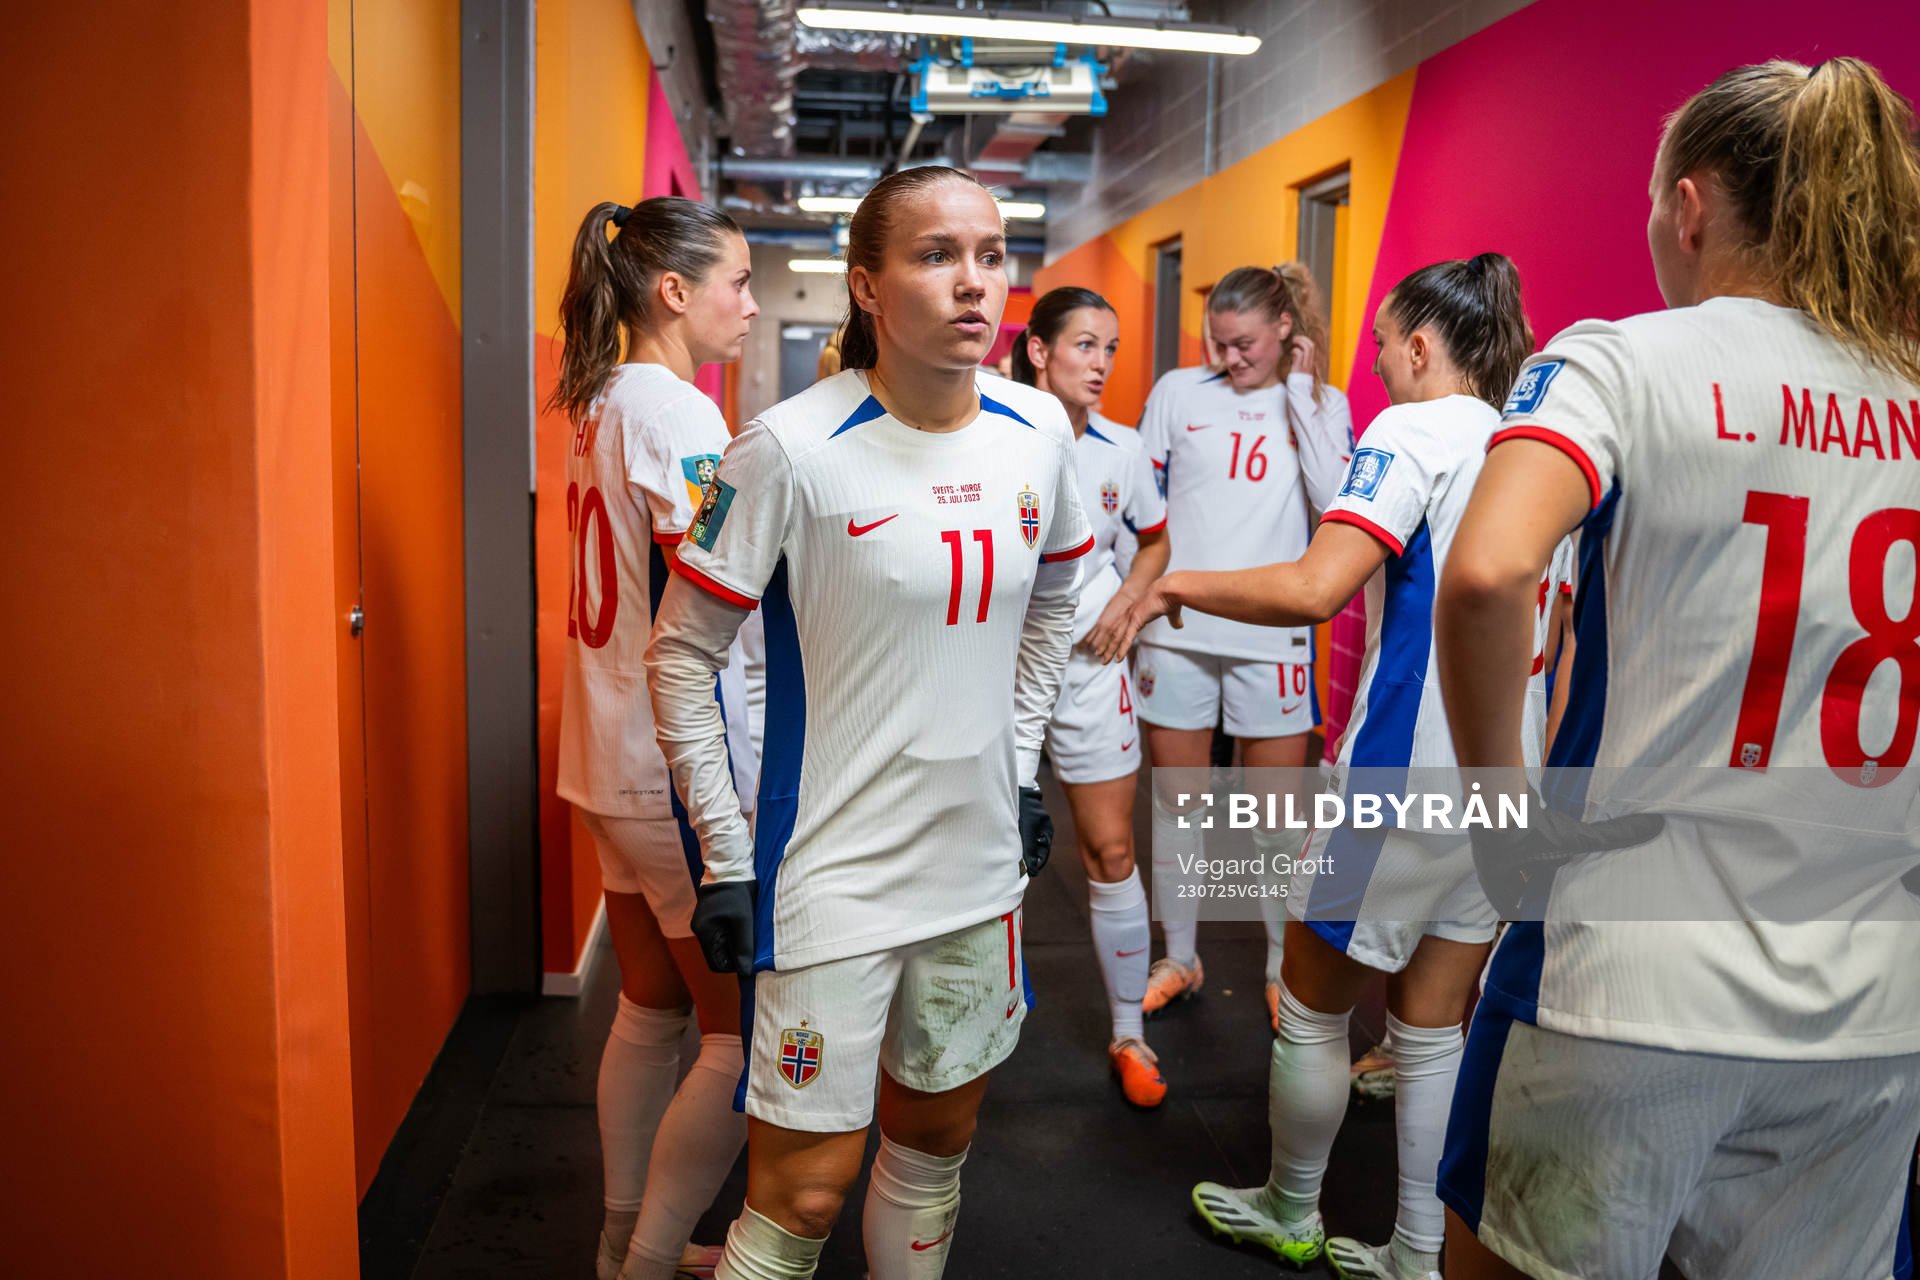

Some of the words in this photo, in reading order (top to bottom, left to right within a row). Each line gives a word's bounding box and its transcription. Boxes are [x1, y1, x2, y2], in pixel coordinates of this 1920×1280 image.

[1712, 383, 1756, 443] L.
[1229, 432, 1268, 482] 16
[932, 485, 954, 495] SVEITS
[960, 483, 982, 493] NORGE
[937, 495, 948, 504] 25.
[949, 494, 962, 504] JULI
[964, 493, 981, 503] 2023
[567, 481, 618, 649] 20
[940, 529, 994, 626] 11
[1729, 490, 1920, 788] 18
[1119, 674, 1133, 725] 4
